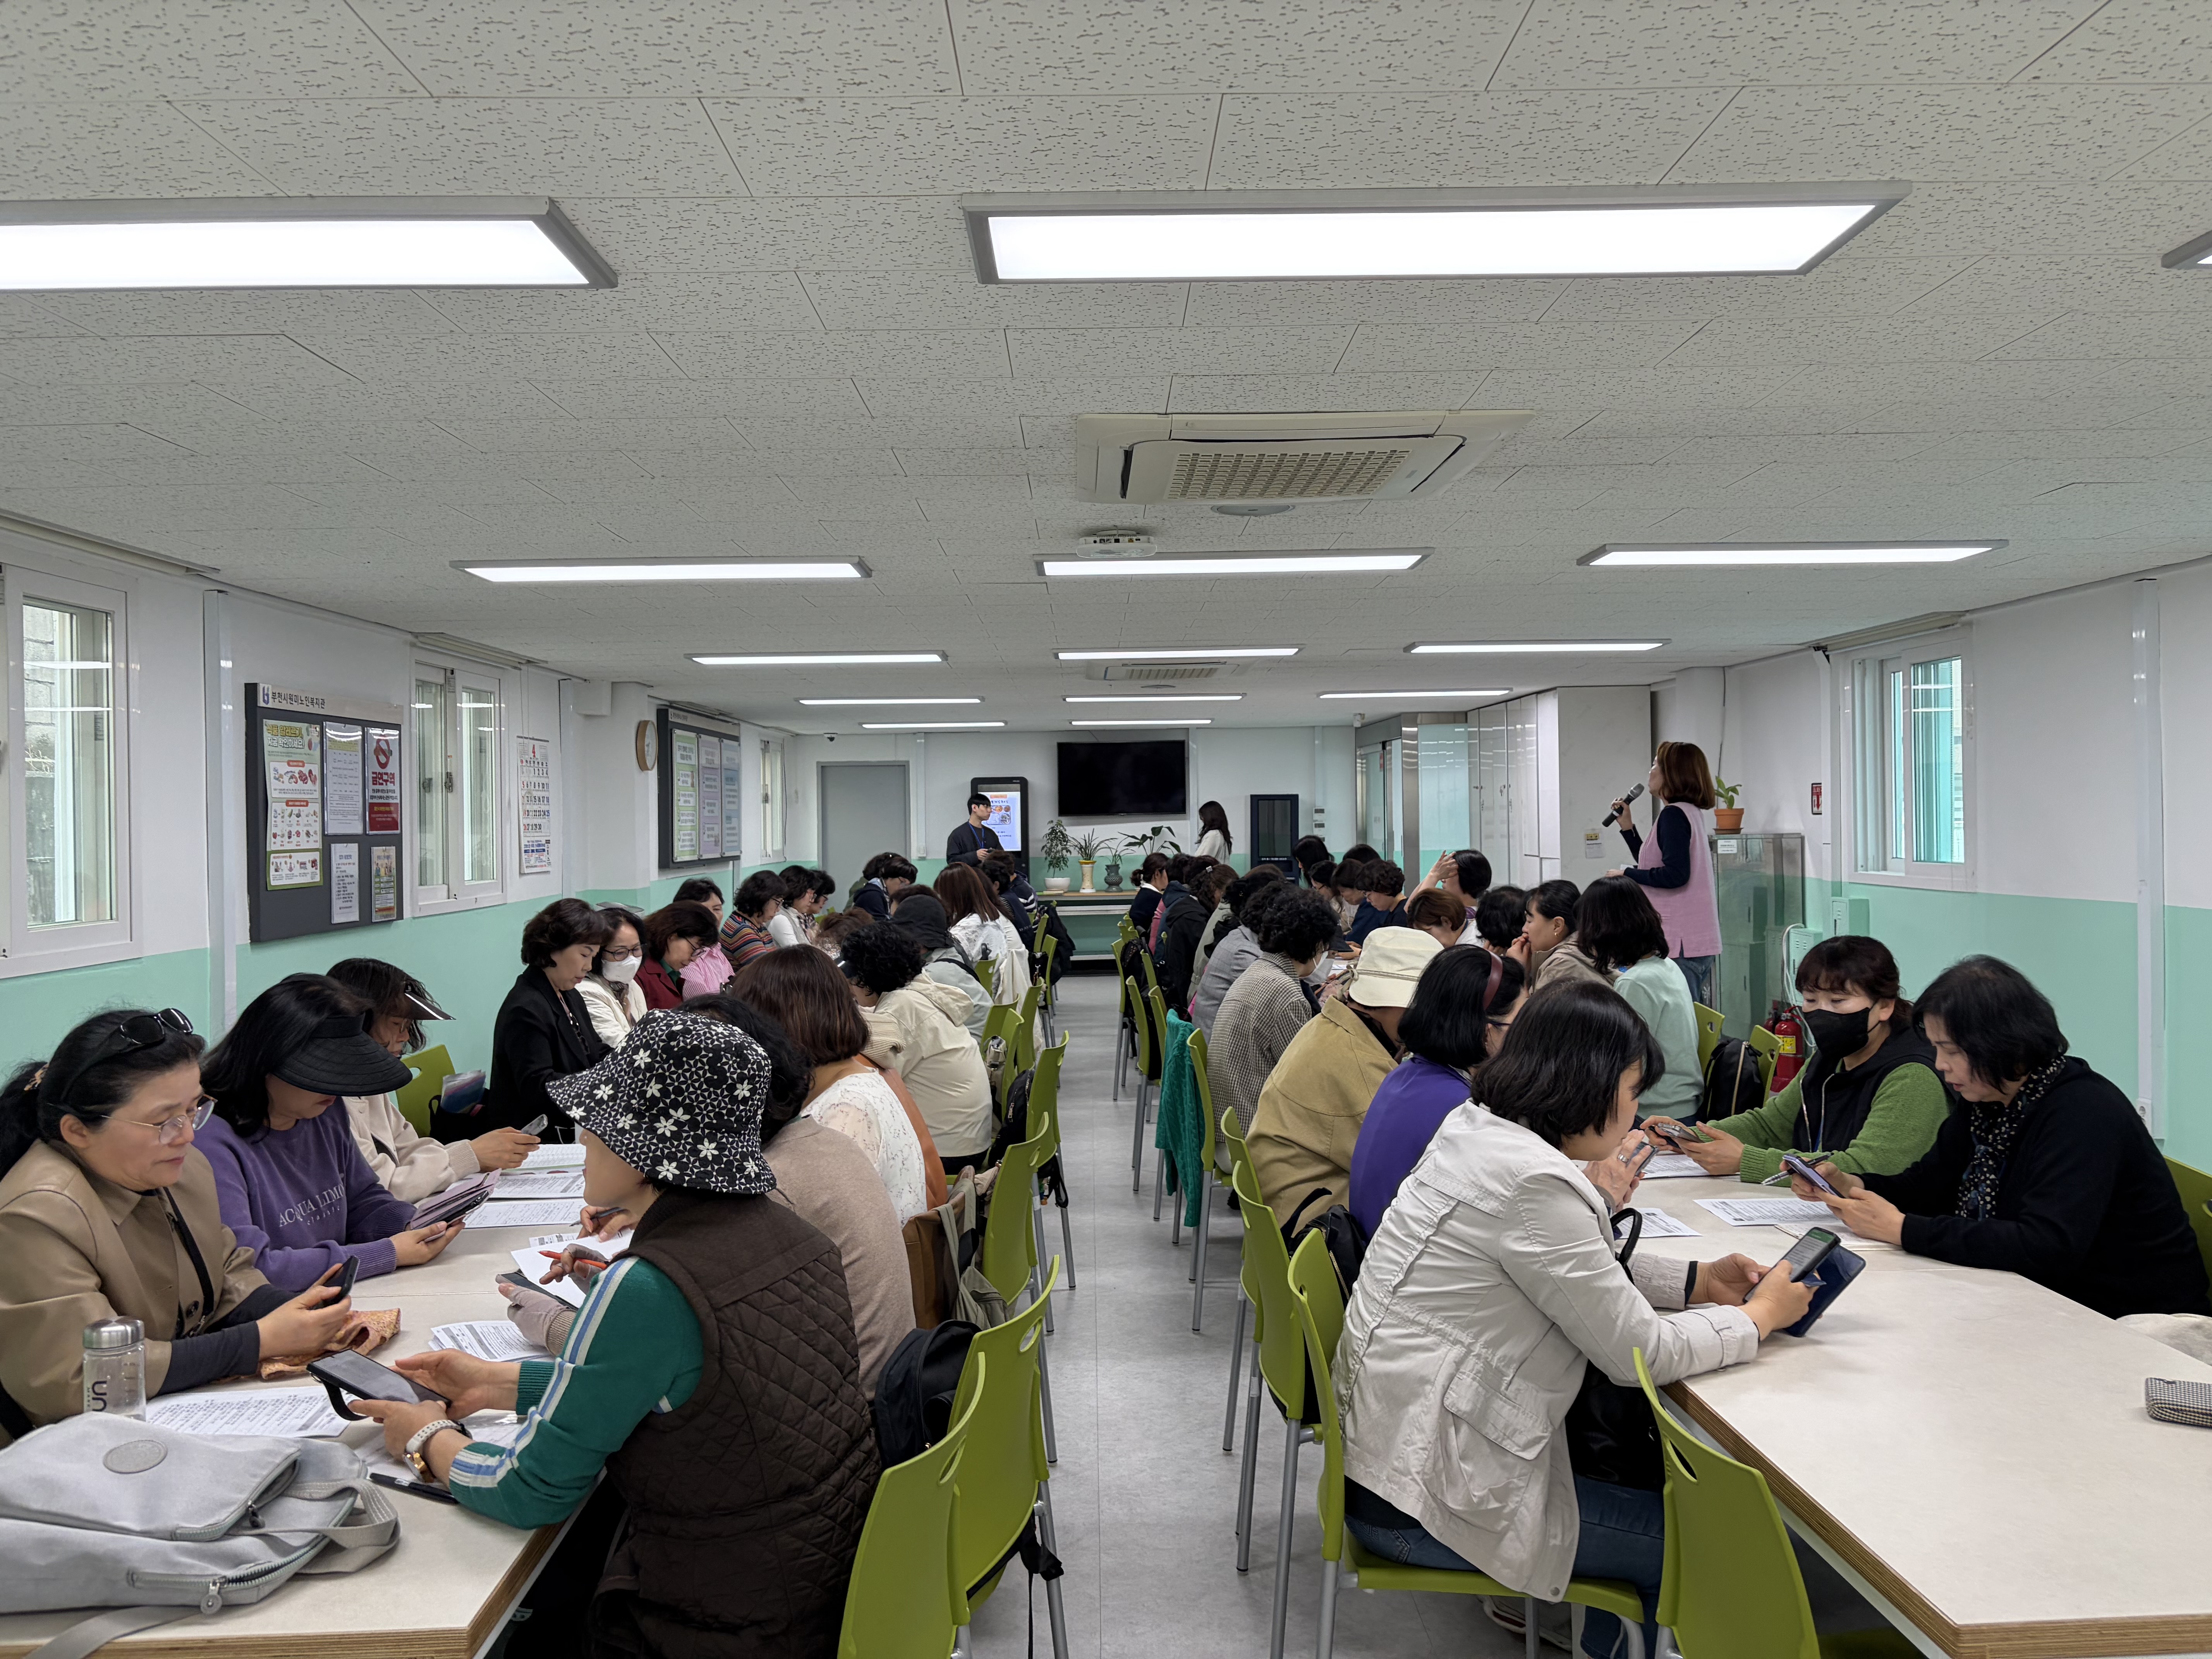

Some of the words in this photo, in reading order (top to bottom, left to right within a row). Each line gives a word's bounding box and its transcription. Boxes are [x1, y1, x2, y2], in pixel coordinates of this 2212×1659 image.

[271, 691, 325, 709] 부천시원미노인복지관
[268, 737, 278, 747] 지금
[532, 744, 536, 758] 4
[372, 771, 395, 786] 금연구역
[279, 1199, 318, 1227] ACQUA
